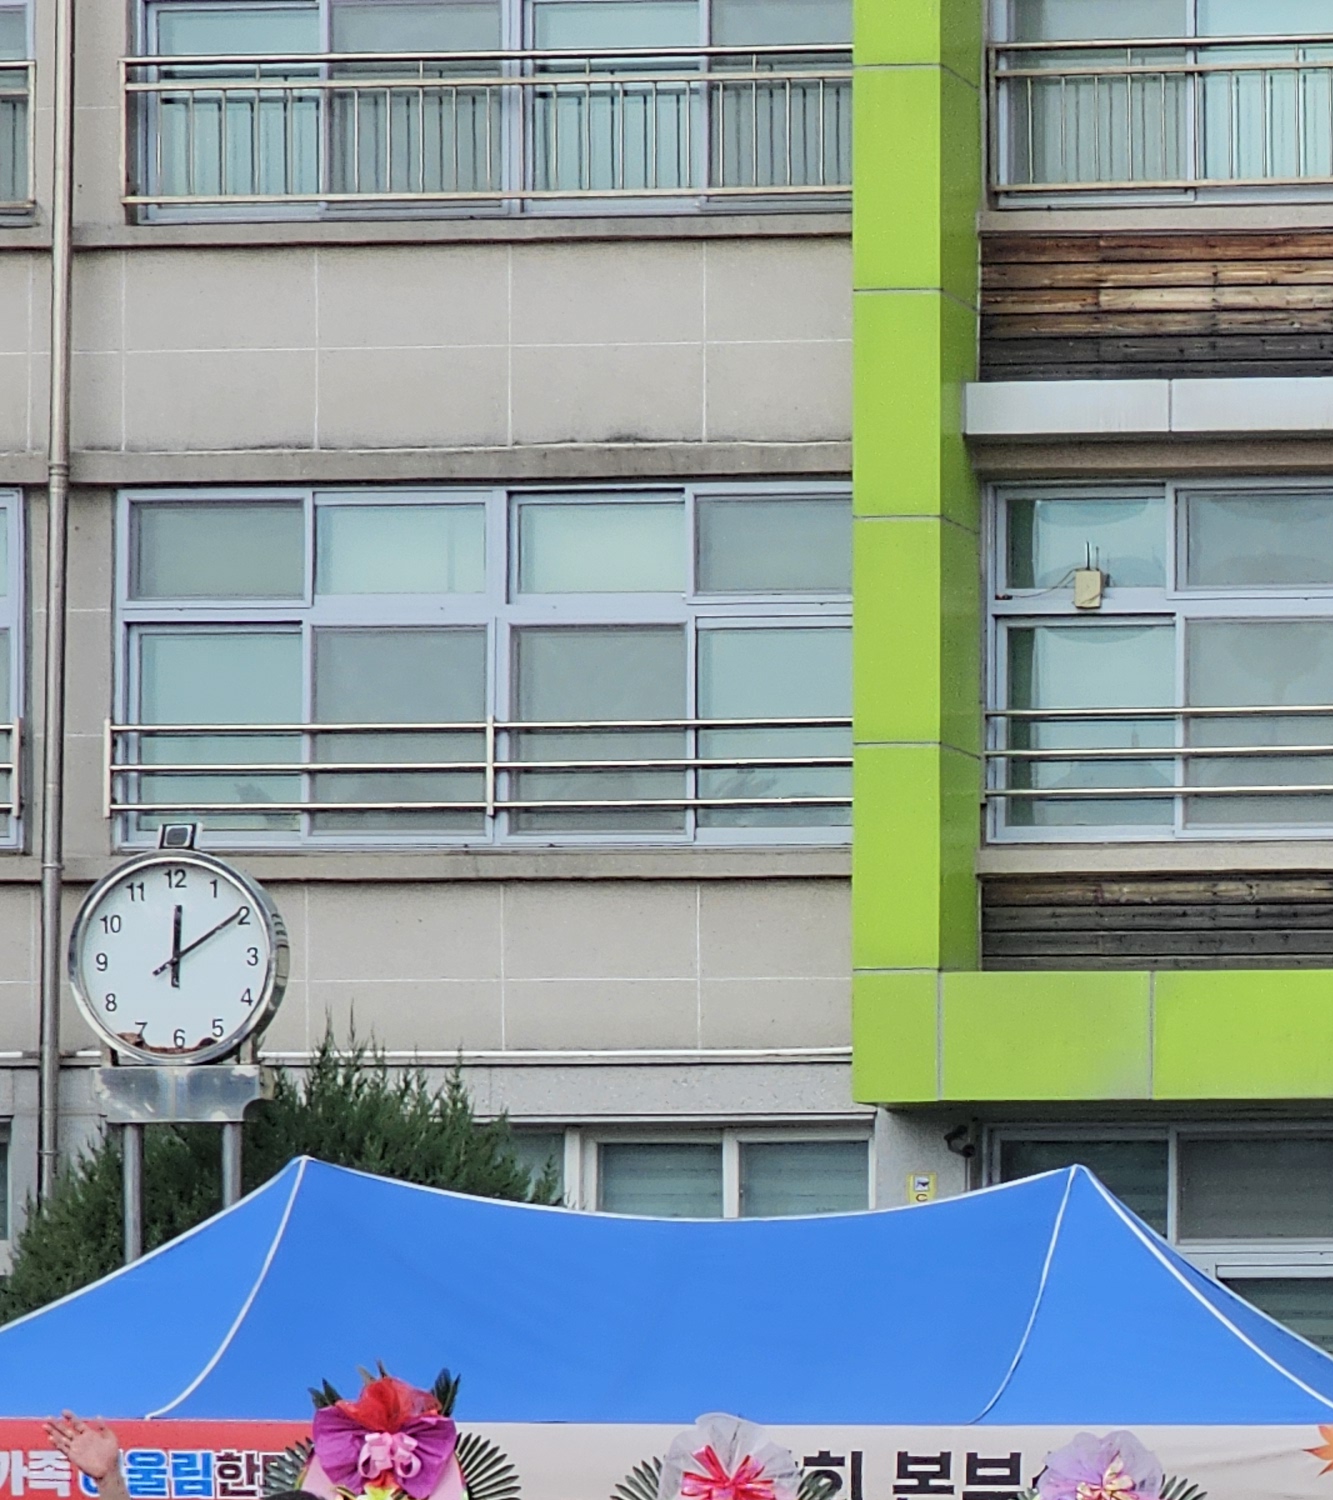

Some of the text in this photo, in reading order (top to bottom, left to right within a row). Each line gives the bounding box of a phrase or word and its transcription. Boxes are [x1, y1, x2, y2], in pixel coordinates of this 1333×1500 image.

[164, 868, 187, 889] 12
[126, 881, 145, 902] 11
[209, 879, 218, 898] 1
[100, 914, 122, 934] 10
[237, 906, 250, 925] 2
[96, 953, 108, 971] 9
[246, 947, 259, 966] 3
[105, 993, 117, 1012] 8
[240, 987, 253, 1006] 4
[135, 1021, 148, 1040] 7
[211, 1018, 224, 1038] 5
[173, 1028, 186, 1049] 6
